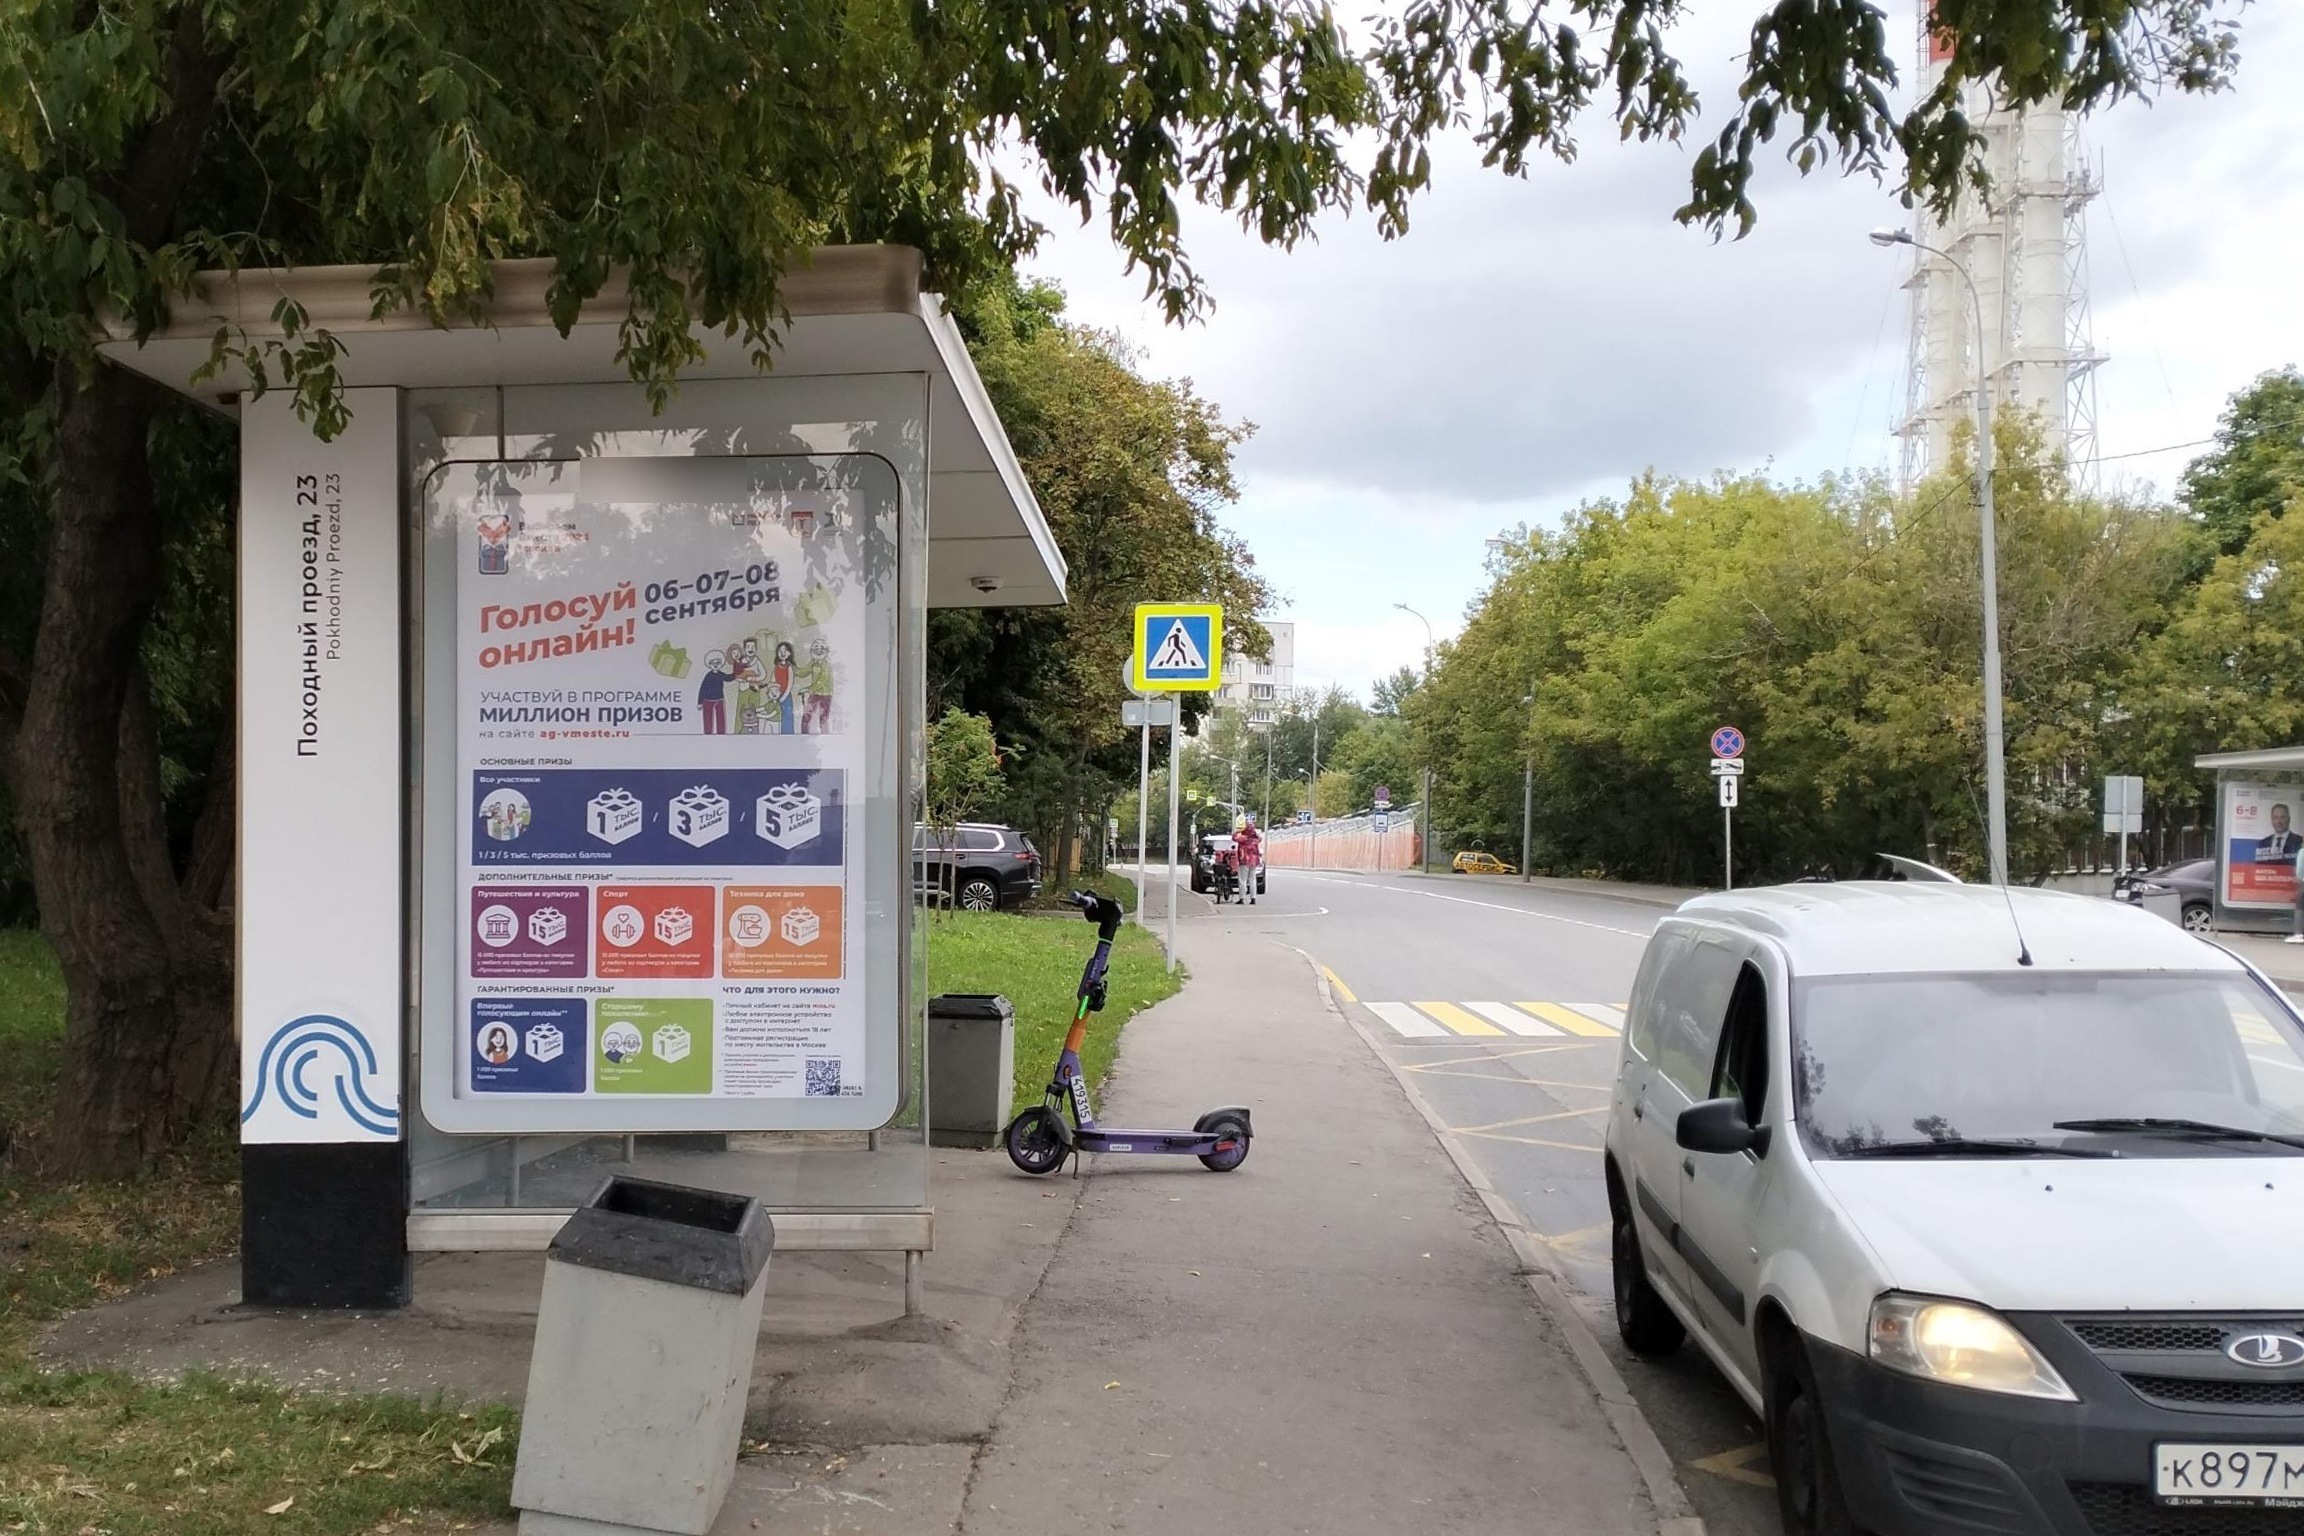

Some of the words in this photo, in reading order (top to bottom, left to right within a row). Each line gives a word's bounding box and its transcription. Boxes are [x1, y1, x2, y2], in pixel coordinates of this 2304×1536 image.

[296, 475, 318, 506] 23
[325, 473, 340, 493] 23
[325, 499, 343, 562] Proezd,
[302, 513, 322, 613] проезд,
[326, 569, 344, 660] Pokhodniy
[480, 581, 636, 634] Голосуй
[645, 587, 780, 624] сентября
[479, 618, 635, 669] онлайн!
[297, 622, 322, 756] Походный
[480, 689, 562, 703] УЧАСТВУЙ
[567, 691, 578, 703] В
[582, 691, 682, 703] ПРОГРАММЕ
[598, 707, 683, 727] призов
[480, 731, 494, 739] на
[499, 729, 535, 739] сайте
[540, 730, 630, 740] ag-vmeste.ru
[480, 758, 535, 766] ОСНОВНЫЕ
[538, 758, 573, 766] ПРИЗЫ
[676, 810, 692, 836] 3
[765, 808, 781, 838] 5
[477, 873, 573, 881] ДОПОЛНИТЕЛЬНЫЕ
[1073, 1079, 1092, 1119] 419315
